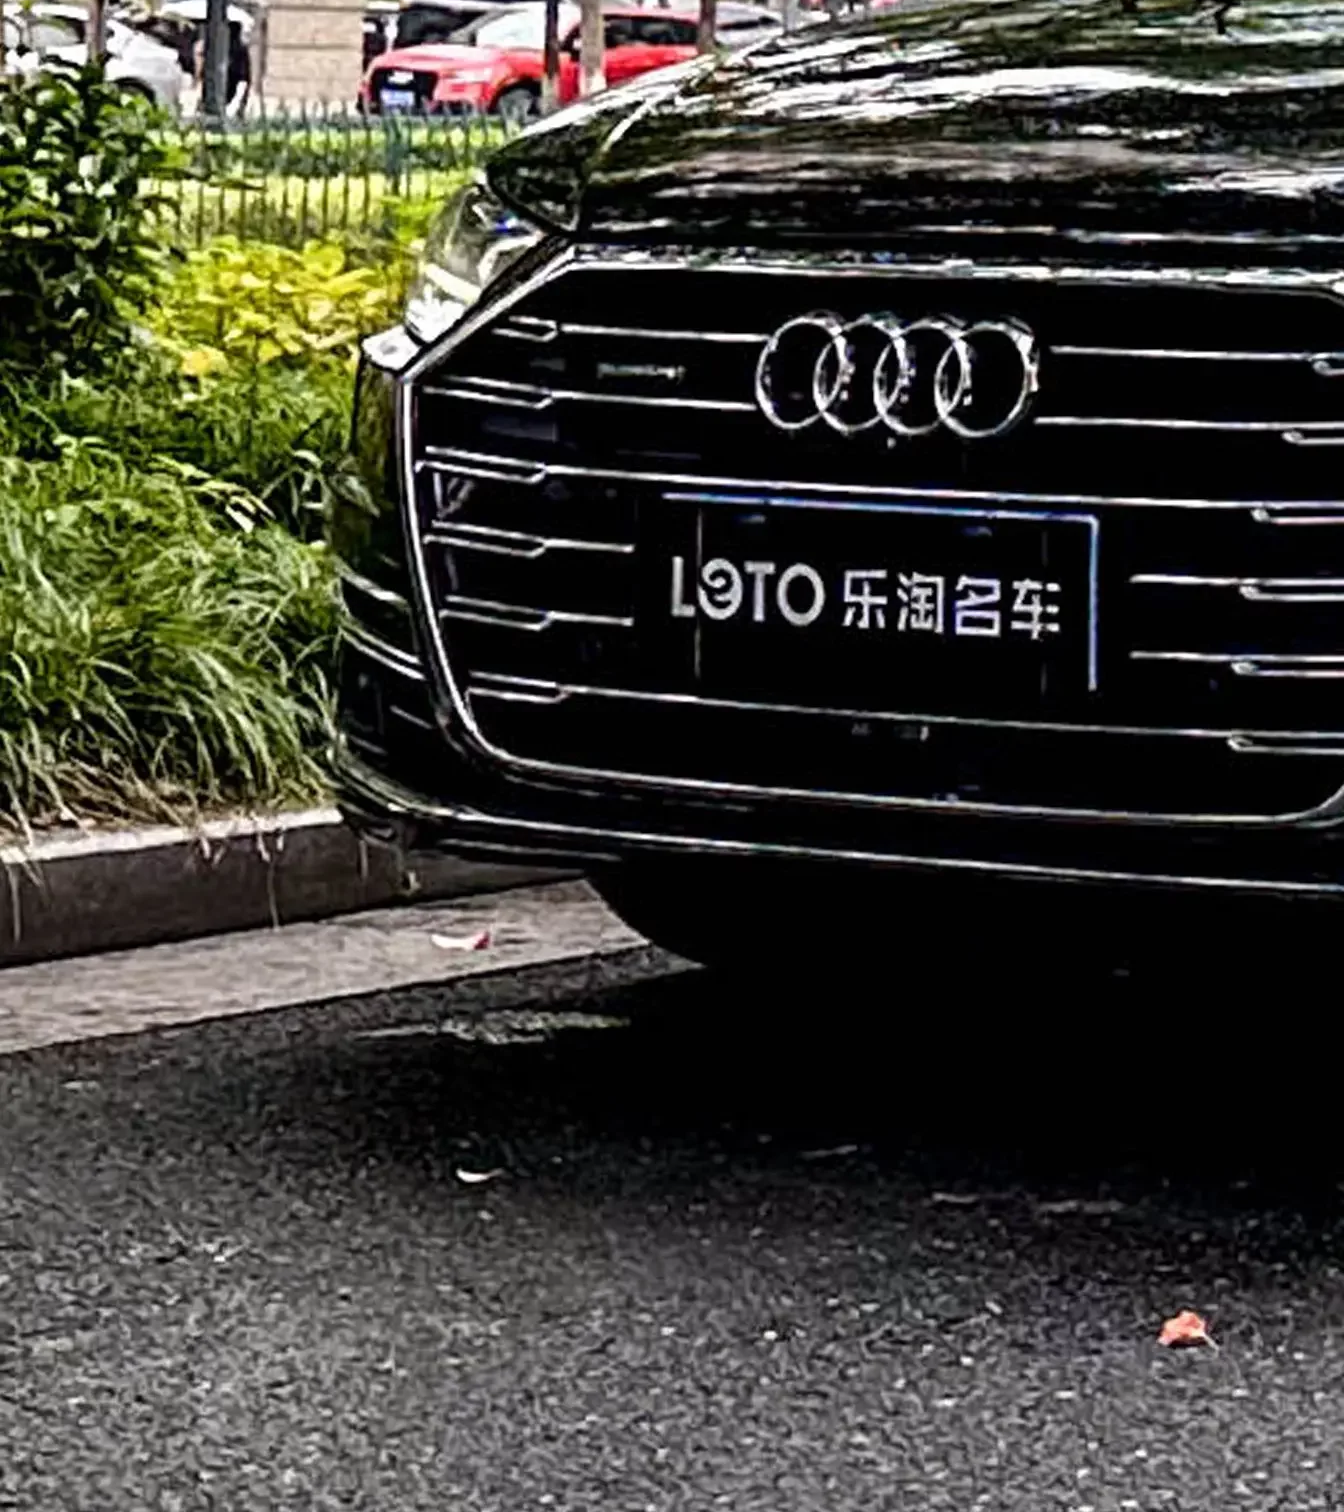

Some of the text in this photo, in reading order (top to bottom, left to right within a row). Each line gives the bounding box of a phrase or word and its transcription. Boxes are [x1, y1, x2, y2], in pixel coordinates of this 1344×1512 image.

[671, 554, 1061, 640] LOTO 乐淘名车
